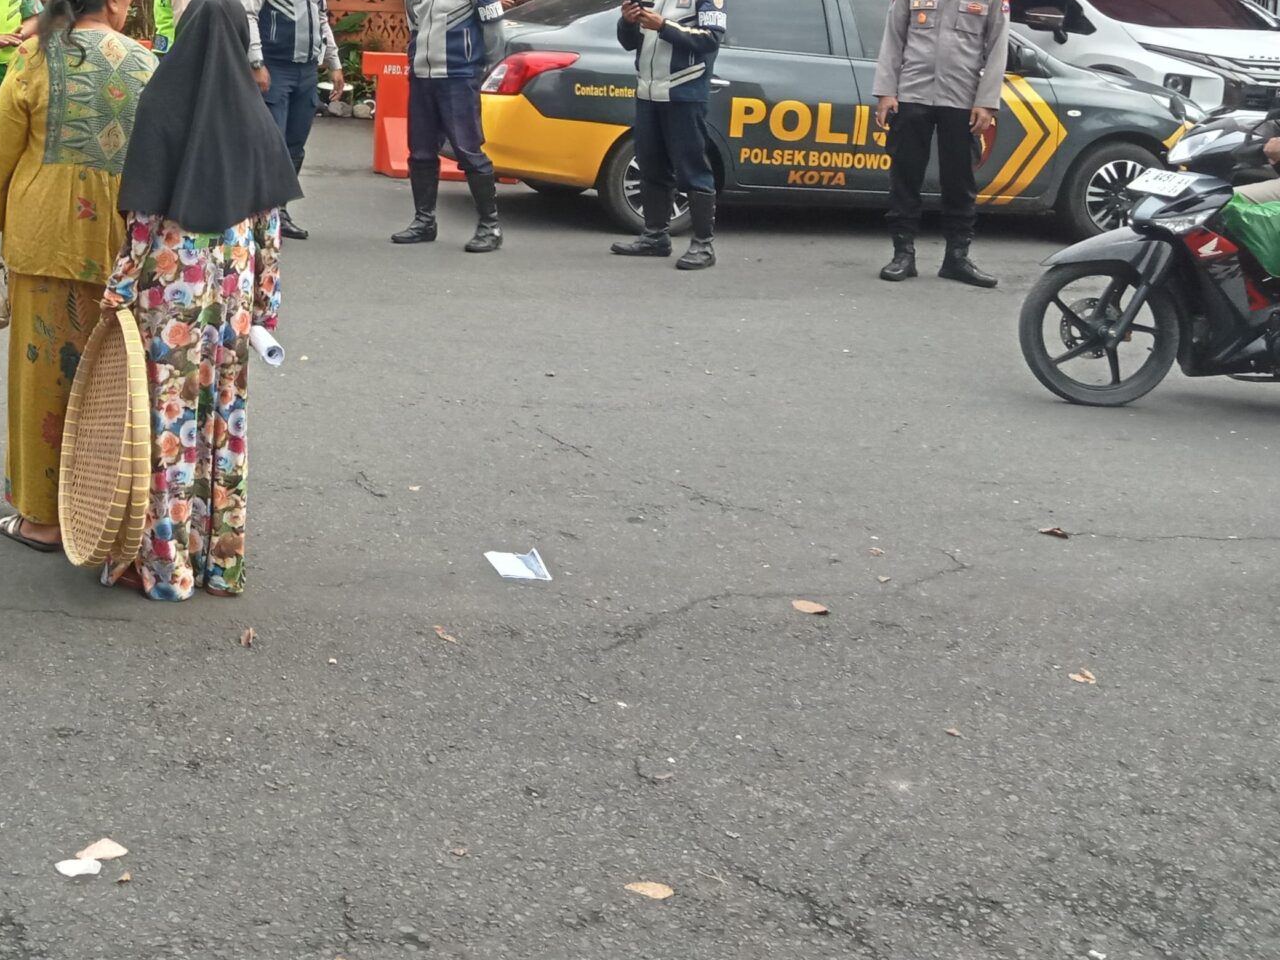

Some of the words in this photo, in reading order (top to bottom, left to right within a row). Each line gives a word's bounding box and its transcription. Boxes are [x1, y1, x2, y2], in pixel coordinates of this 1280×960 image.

[575, 82, 607, 96] Contact
[609, 84, 636, 98] Center
[740, 147, 807, 167] POLSEK
[787, 170, 846, 186] KOTA
